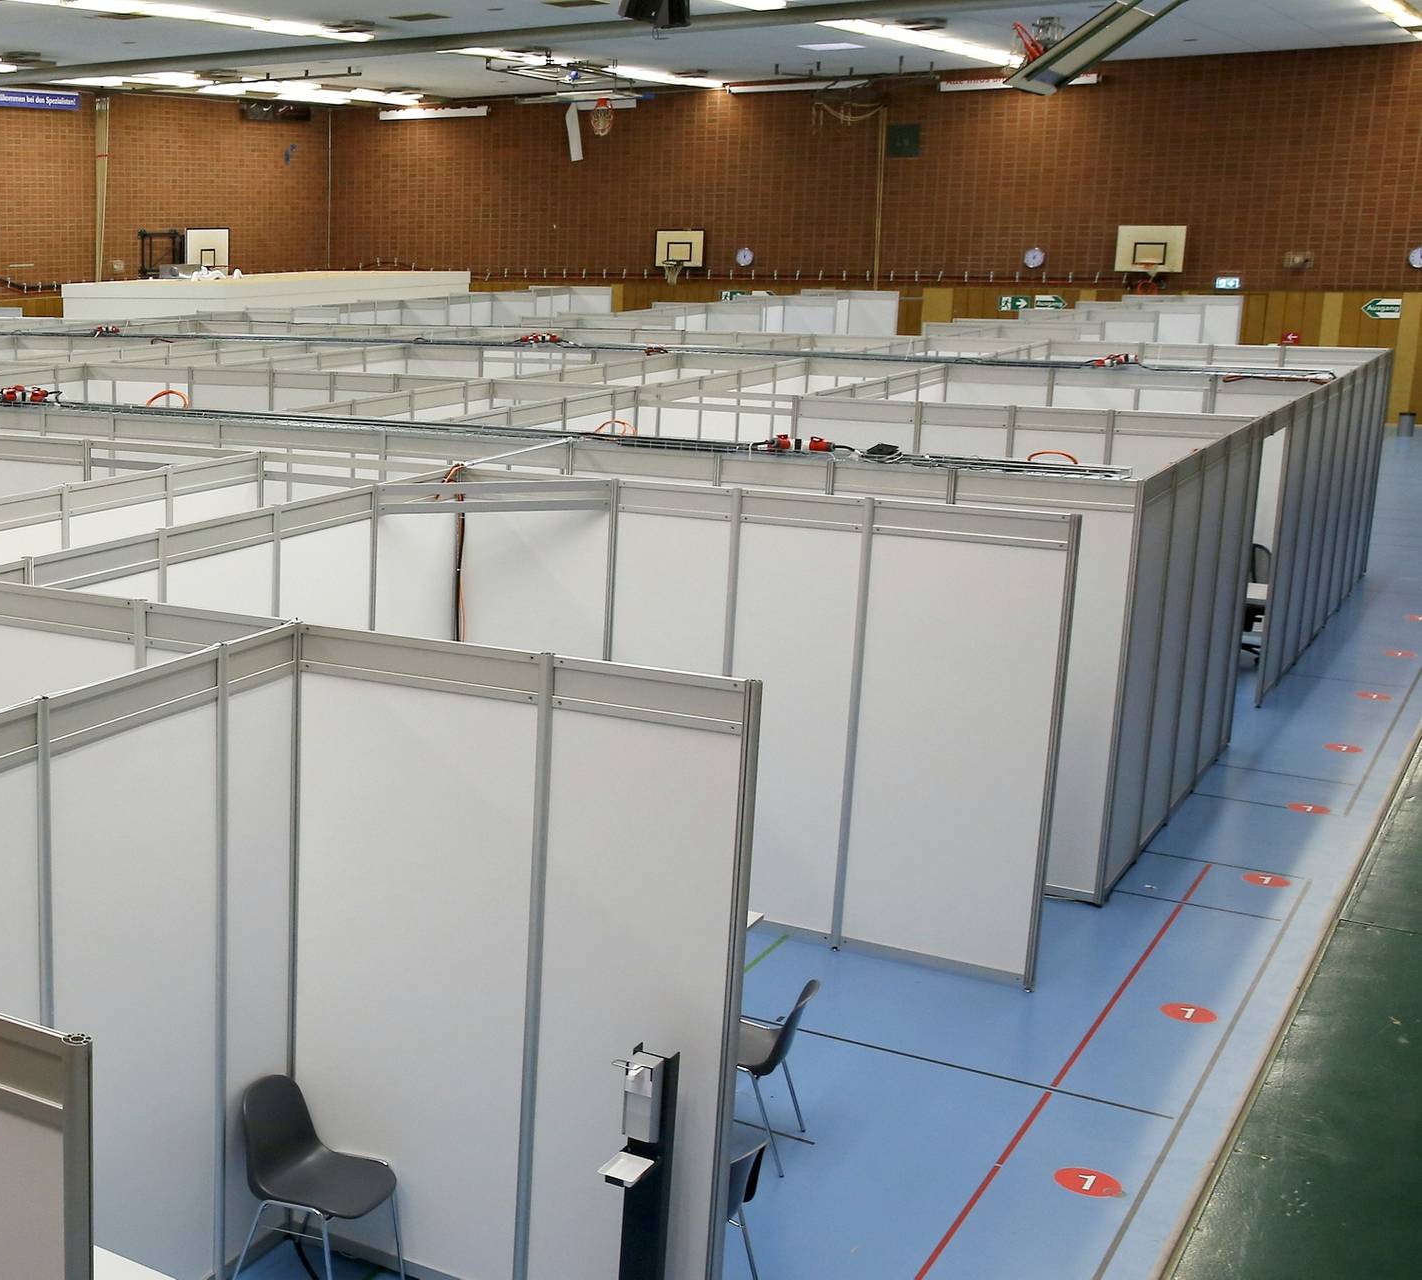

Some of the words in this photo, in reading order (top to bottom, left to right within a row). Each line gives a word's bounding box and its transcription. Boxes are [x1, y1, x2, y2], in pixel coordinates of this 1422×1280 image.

[1366, 304, 1400, 313] Ausgang
[1179, 1006, 1196, 1020] 1
[1078, 1173, 1097, 1191] 1
